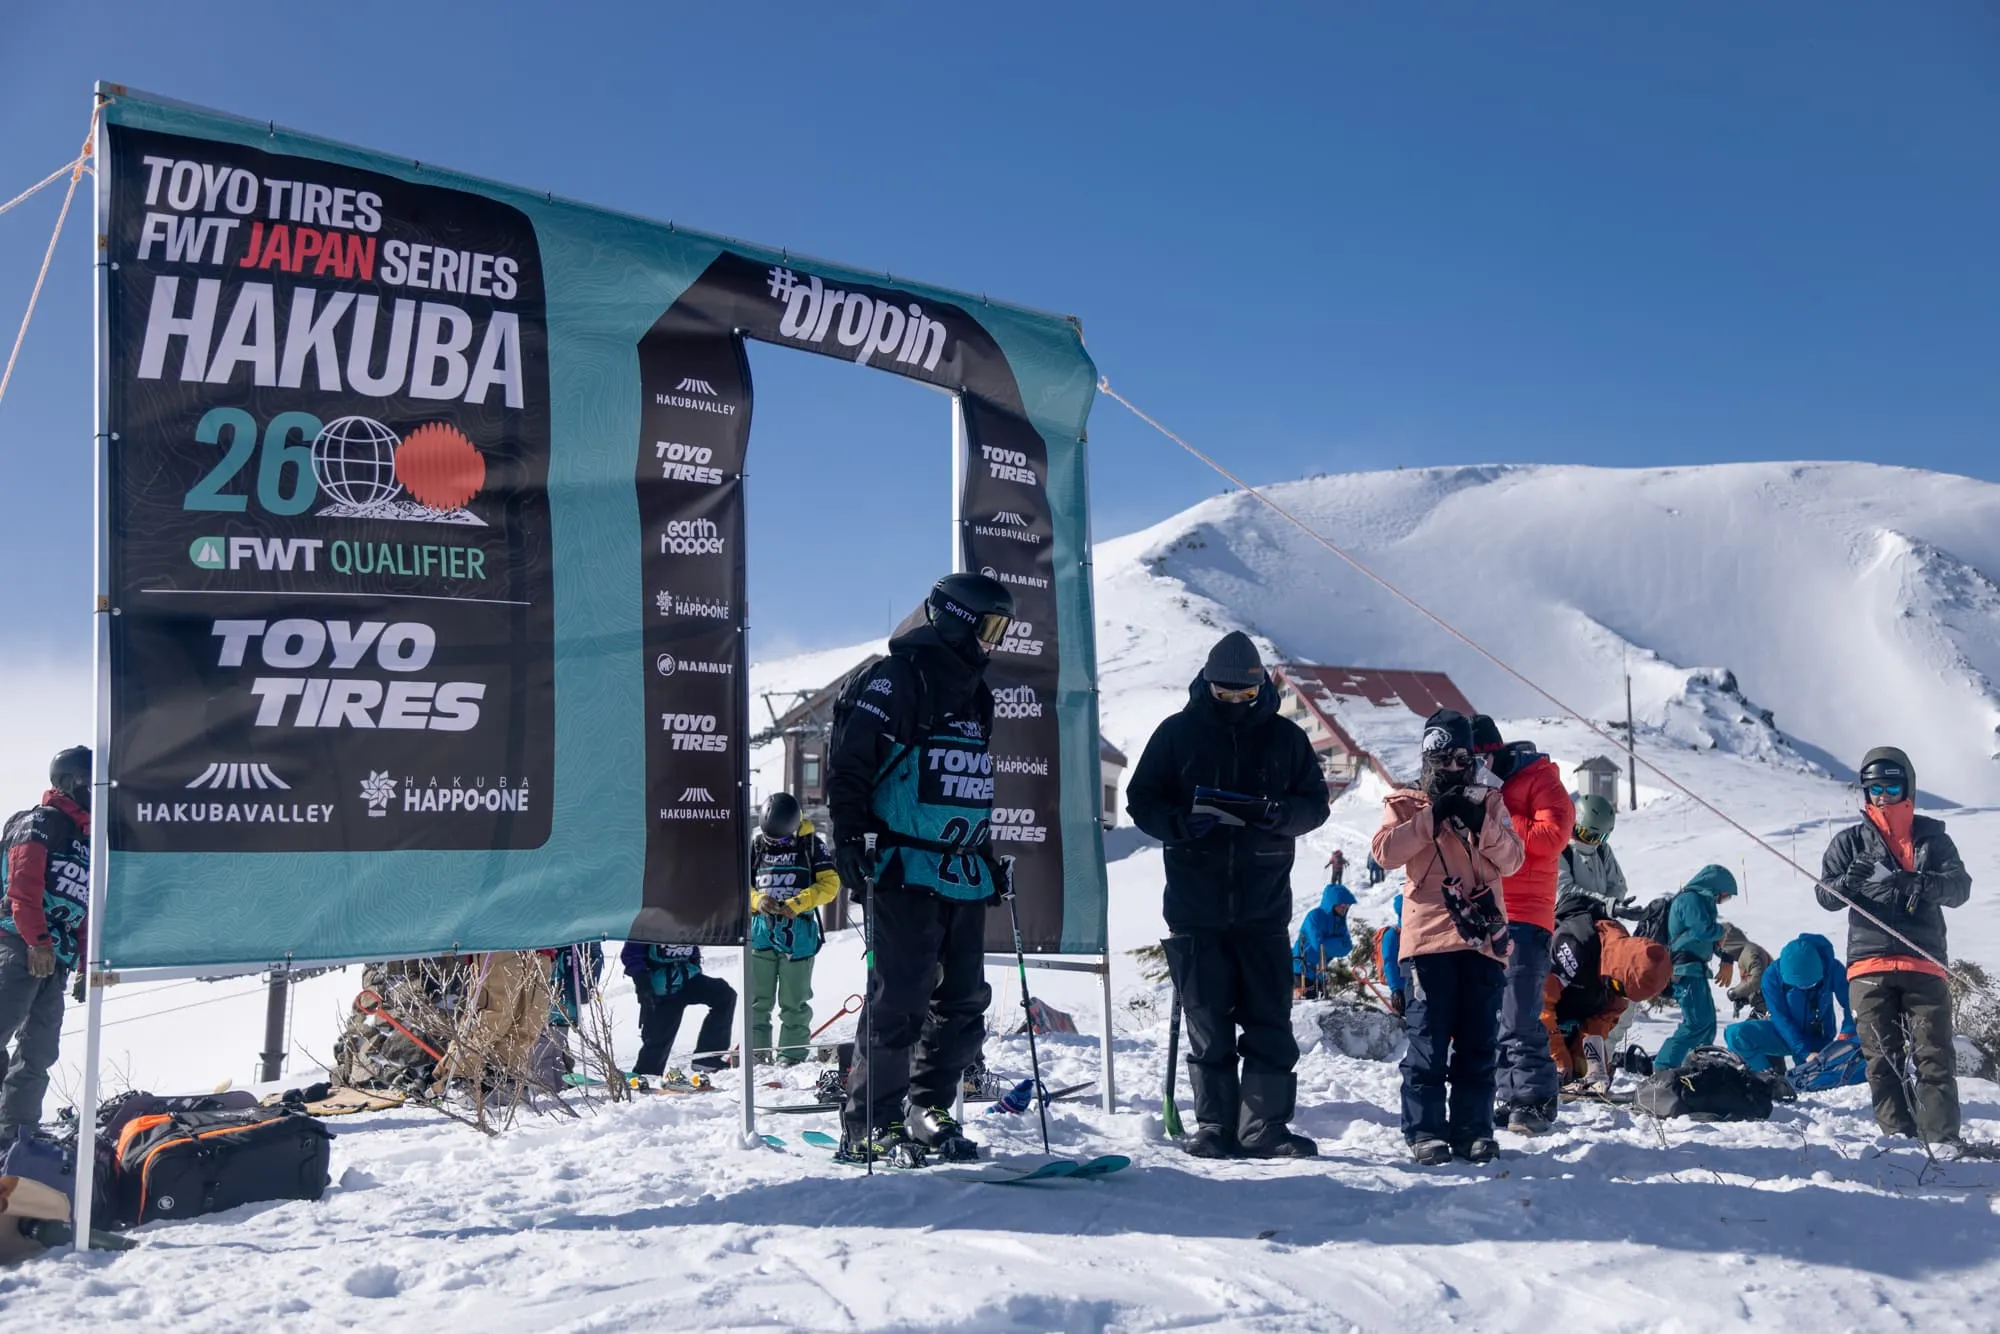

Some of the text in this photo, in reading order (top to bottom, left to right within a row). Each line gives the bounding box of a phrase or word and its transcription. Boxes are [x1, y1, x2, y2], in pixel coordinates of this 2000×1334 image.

[143, 155, 383, 233] TOYO TIRES
[137, 212, 519, 300] FWT JAPAN SERIES
[767, 266, 947, 372] #dropin
[137, 275, 525, 409] HAKUBA
[656, 393, 736, 416] HAKUBAVALLEY
[656, 441, 713, 465] TOYO
[981, 445, 1027, 467] TOYO
[662, 461, 724, 485] TIRES
[990, 462, 1037, 486] TIRES
[667, 518, 717, 538] earth
[975, 525, 1041, 544] HAKUBAVALLEY
[661, 534, 725, 556] hopper
[229, 536, 486, 580] FWT QUALIFIER
[1000, 572, 1048, 589] MAMMUT
[945, 601, 977, 624] SMITH
[1004, 619, 1033, 638] YO
[211, 618, 436, 672] TOYO
[678, 660, 733, 675] MAMMUT
[250, 677, 487, 732] TIRES
[661, 713, 717, 733] TOYO
[671, 733, 728, 752] TIRES
[928, 748, 991, 775] TOYO
[405, 776, 529, 788] HAKUBA
[940, 774, 994, 800] TIRE
[137, 803, 335, 823] HAKUBAVALLEY
[660, 808, 731, 819] HAKUBAVALLEY
[991, 807, 1035, 824] OYO
[51, 860, 90, 887] TOY
